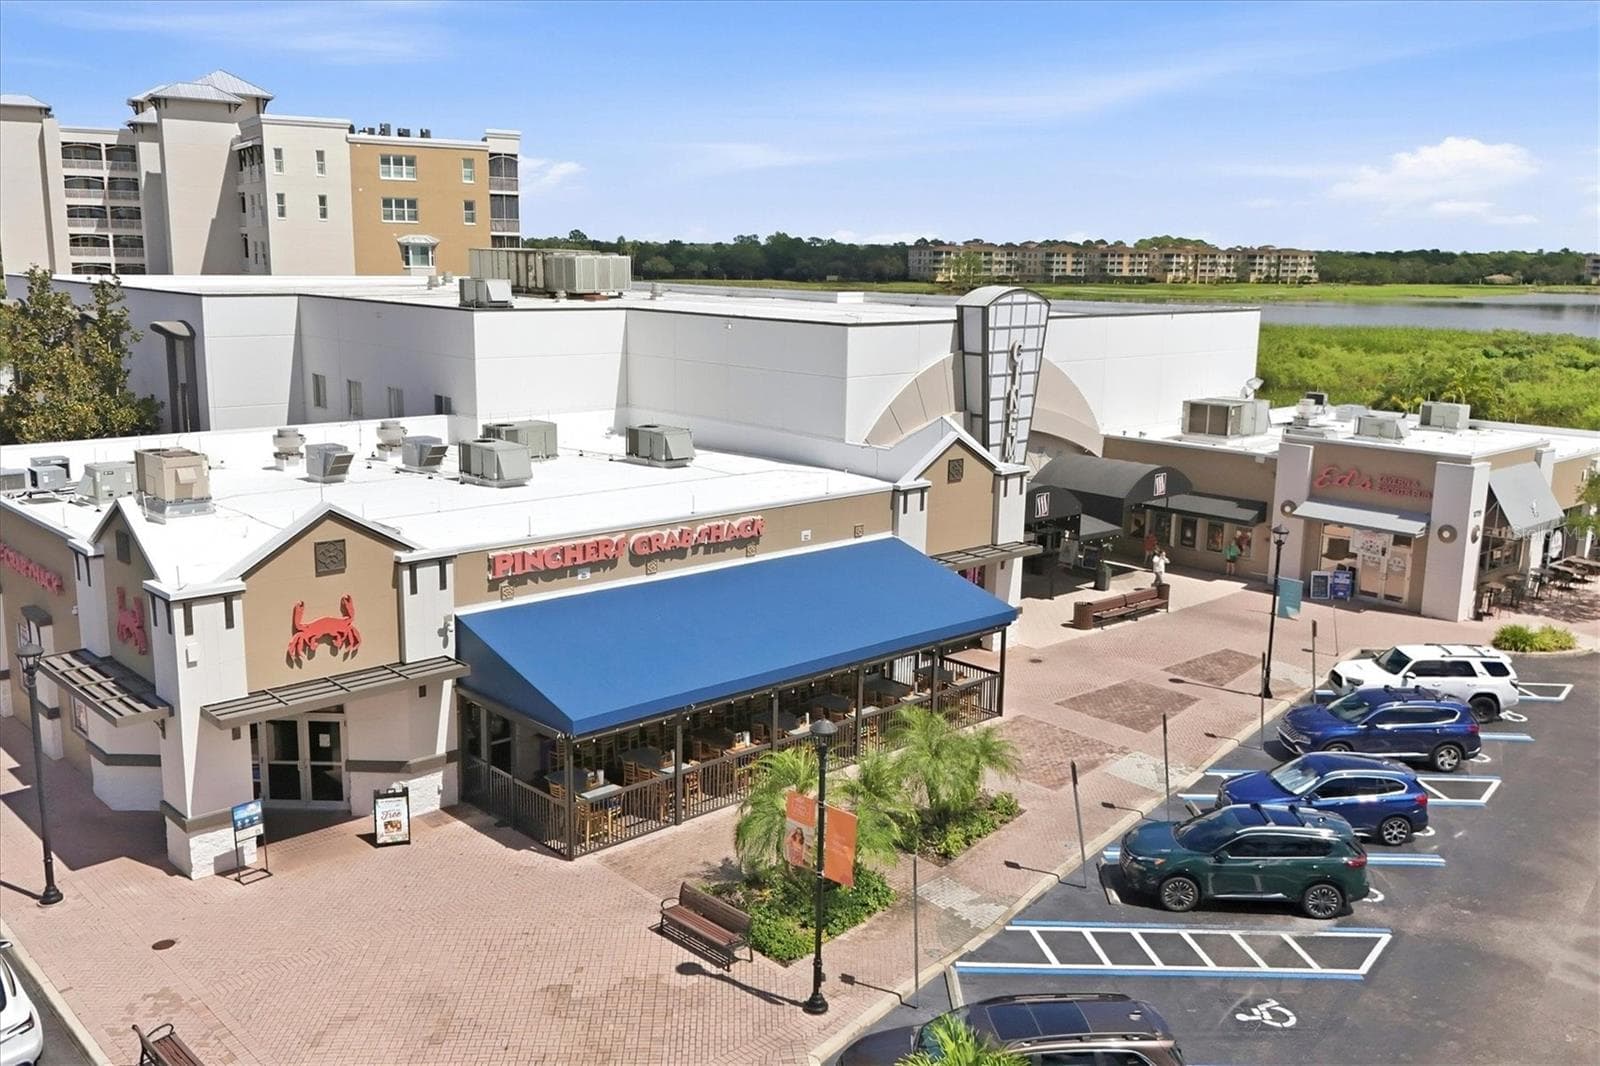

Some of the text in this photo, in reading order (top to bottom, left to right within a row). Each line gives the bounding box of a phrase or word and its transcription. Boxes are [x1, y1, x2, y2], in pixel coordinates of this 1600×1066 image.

[1005, 339, 1024, 466] CINEM
[488, 515, 767, 578] PINCHERS CRAB SHACK
